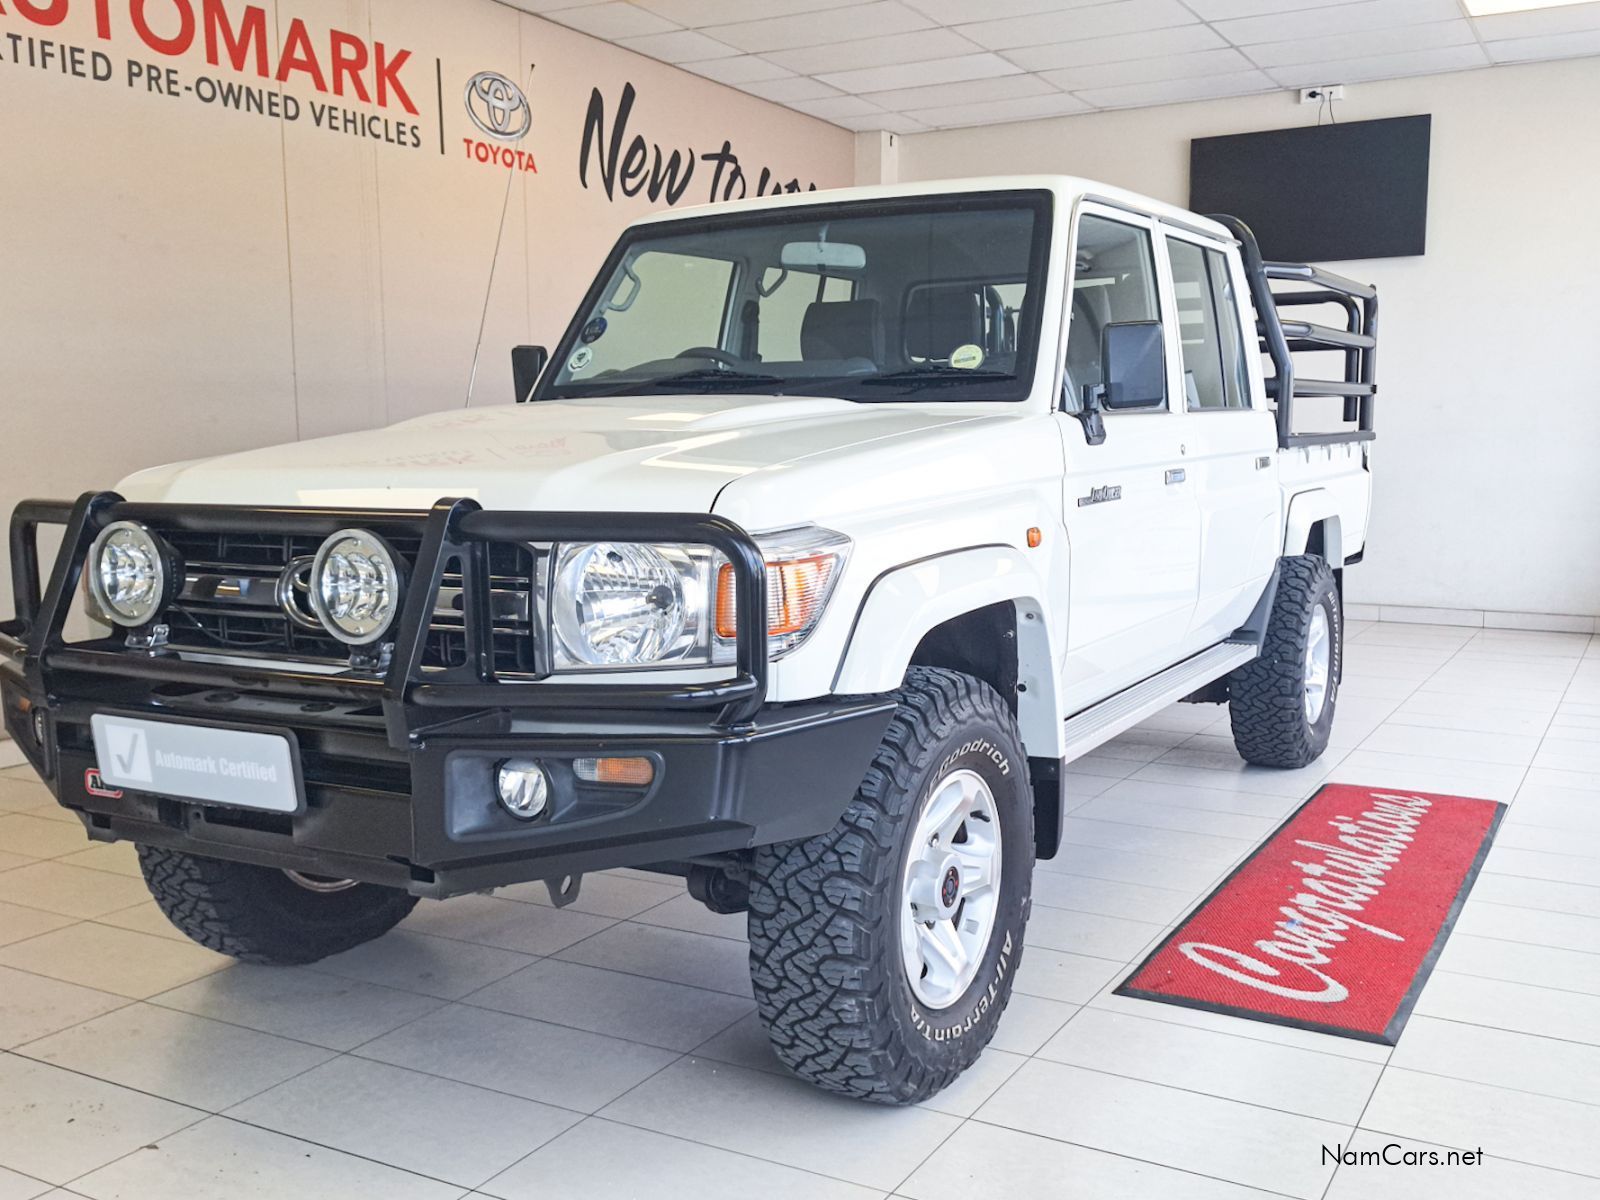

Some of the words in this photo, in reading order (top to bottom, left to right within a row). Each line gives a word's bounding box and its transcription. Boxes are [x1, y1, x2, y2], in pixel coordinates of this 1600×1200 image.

[0, 0, 420, 116] OMARK
[0, 32, 112, 82] TIFIED
[127, 60, 300, 122] PRE-OWNED
[310, 101, 421, 148] VEHICLES
[463, 138, 537, 173] TOYOTA
[579, 82, 695, 207] New
[701, 140, 746, 203] to
[155, 749, 217, 774] Automark
[219, 757, 277, 782] Certified
[1178, 793, 1433, 1003] Congratulations
[910, 1003, 931, 1041] T/A
[934, 929, 1012, 1045] All-Terrain
